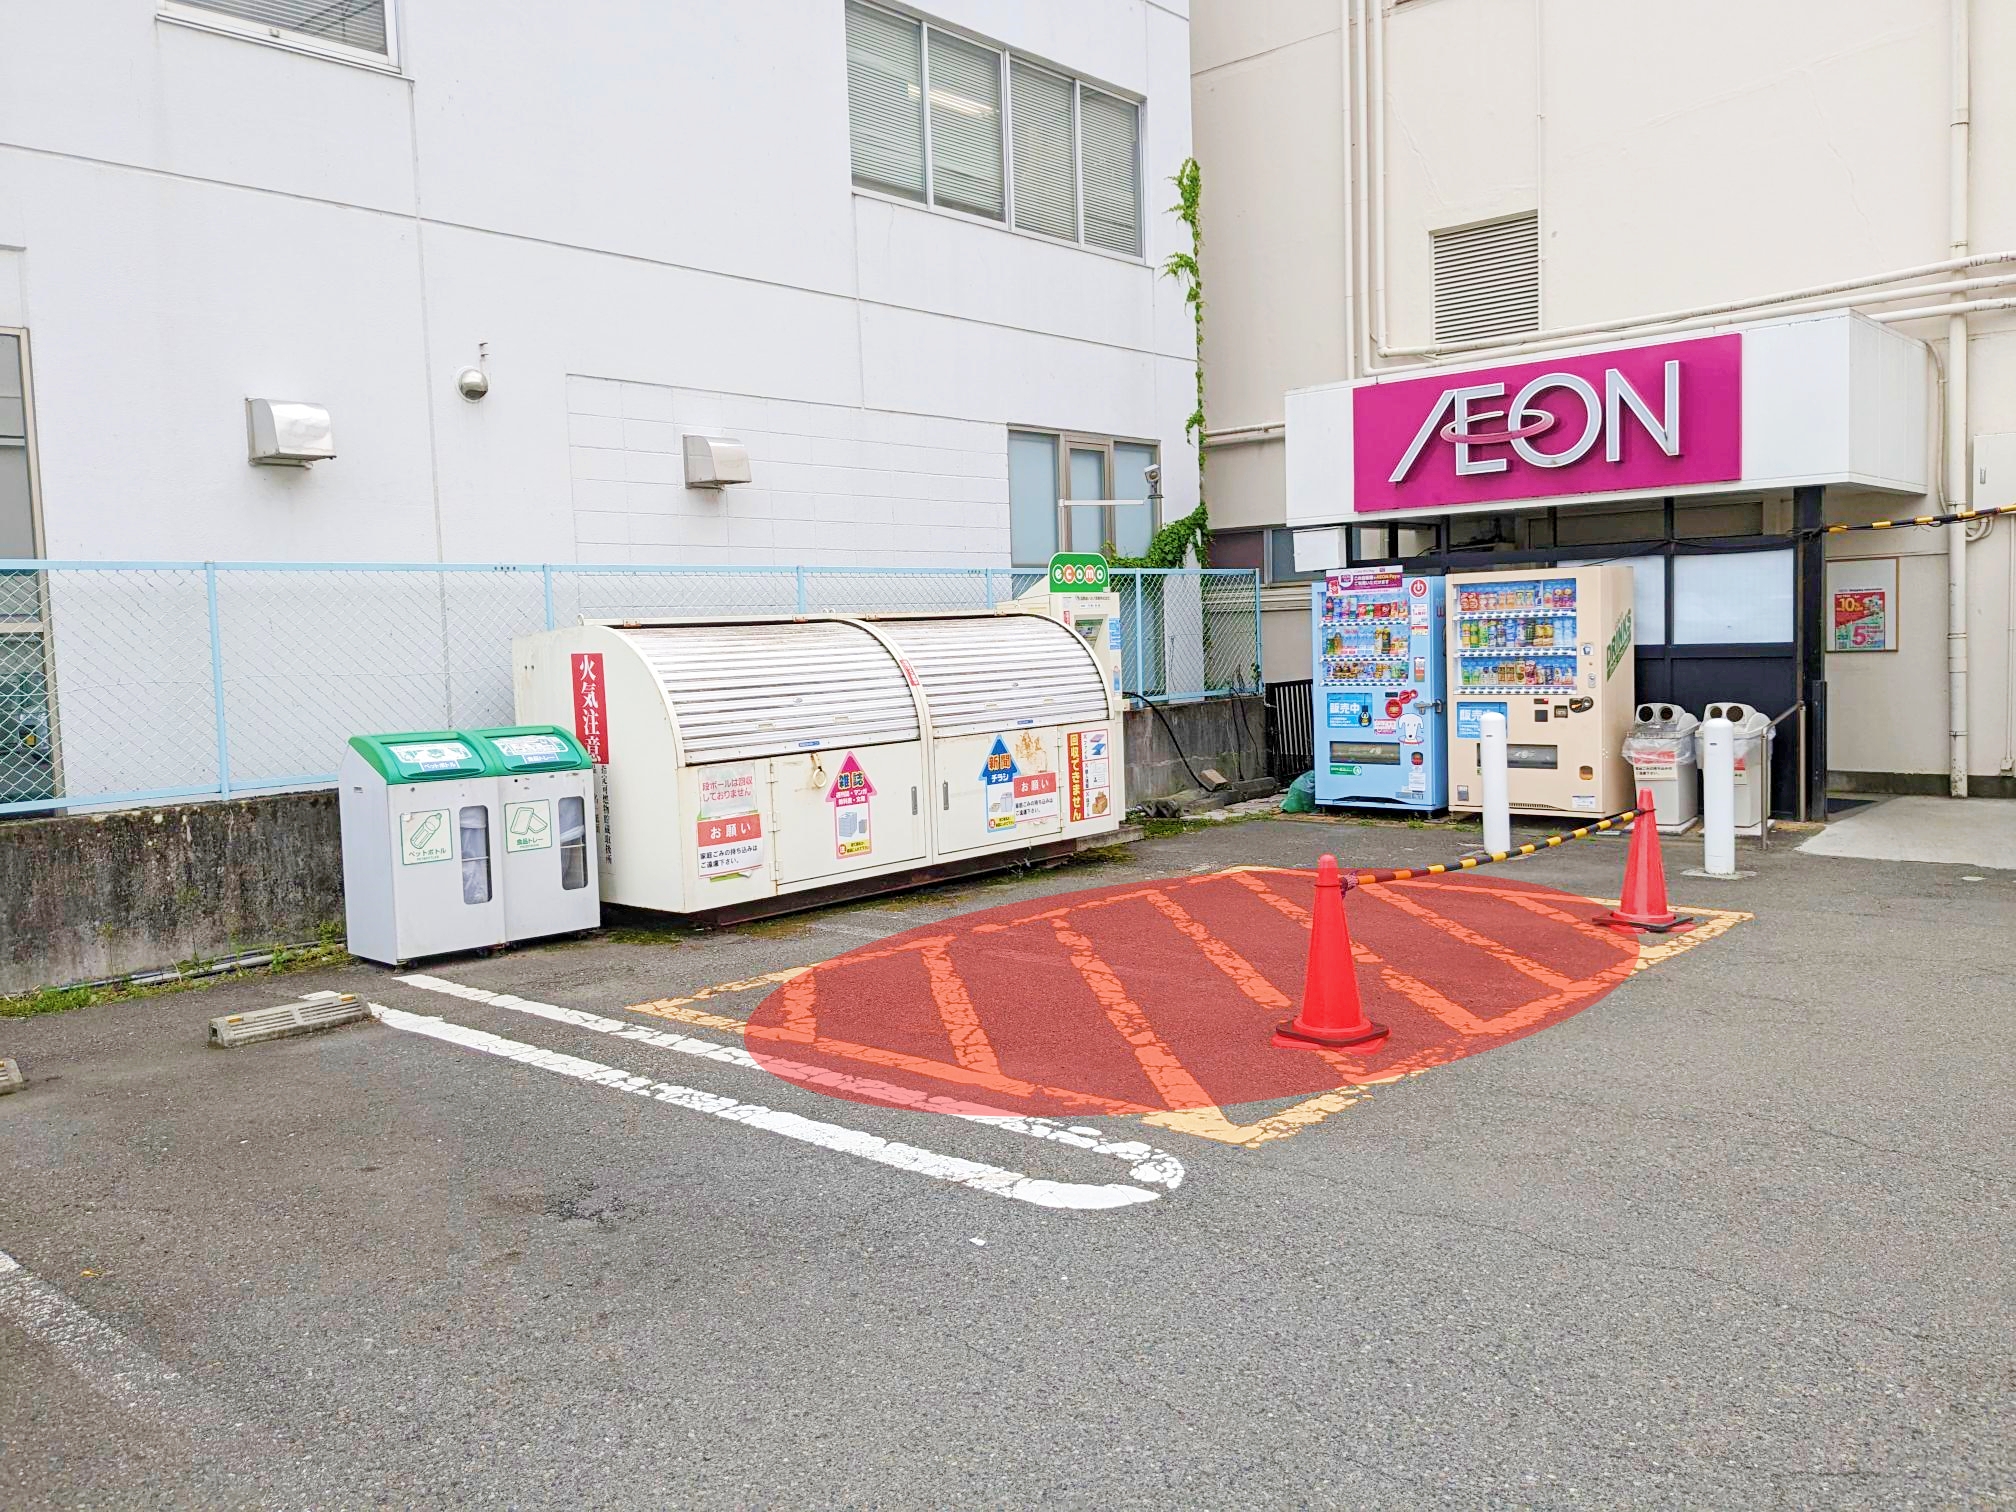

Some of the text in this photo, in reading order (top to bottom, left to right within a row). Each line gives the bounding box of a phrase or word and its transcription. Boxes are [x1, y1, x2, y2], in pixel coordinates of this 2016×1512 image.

[1053, 565, 1105, 583] ecomo
[1607, 615, 1631, 669] DRINKS
[580, 654, 602, 762] 火気注意
[1330, 702, 1360, 714] 販売中
[423, 761, 457, 769] ペットボトル
[988, 754, 1011, 770] 新聞
[702, 776, 753, 791] 段ボールは回収
[839, 770, 864, 789] 雑誌
[991, 773, 1009, 783] チラシ
[1070, 734, 1082, 821] 回収できません
[1021, 779, 1049, 792] お願い
[703, 788, 752, 802] しておりません
[710, 823, 751, 840] お願い
[517, 837, 544, 846] 食品トレー
[408, 848, 447, 858] ペットボトル
[700, 845, 758, 860] 家庭ごみの持ち込みは
